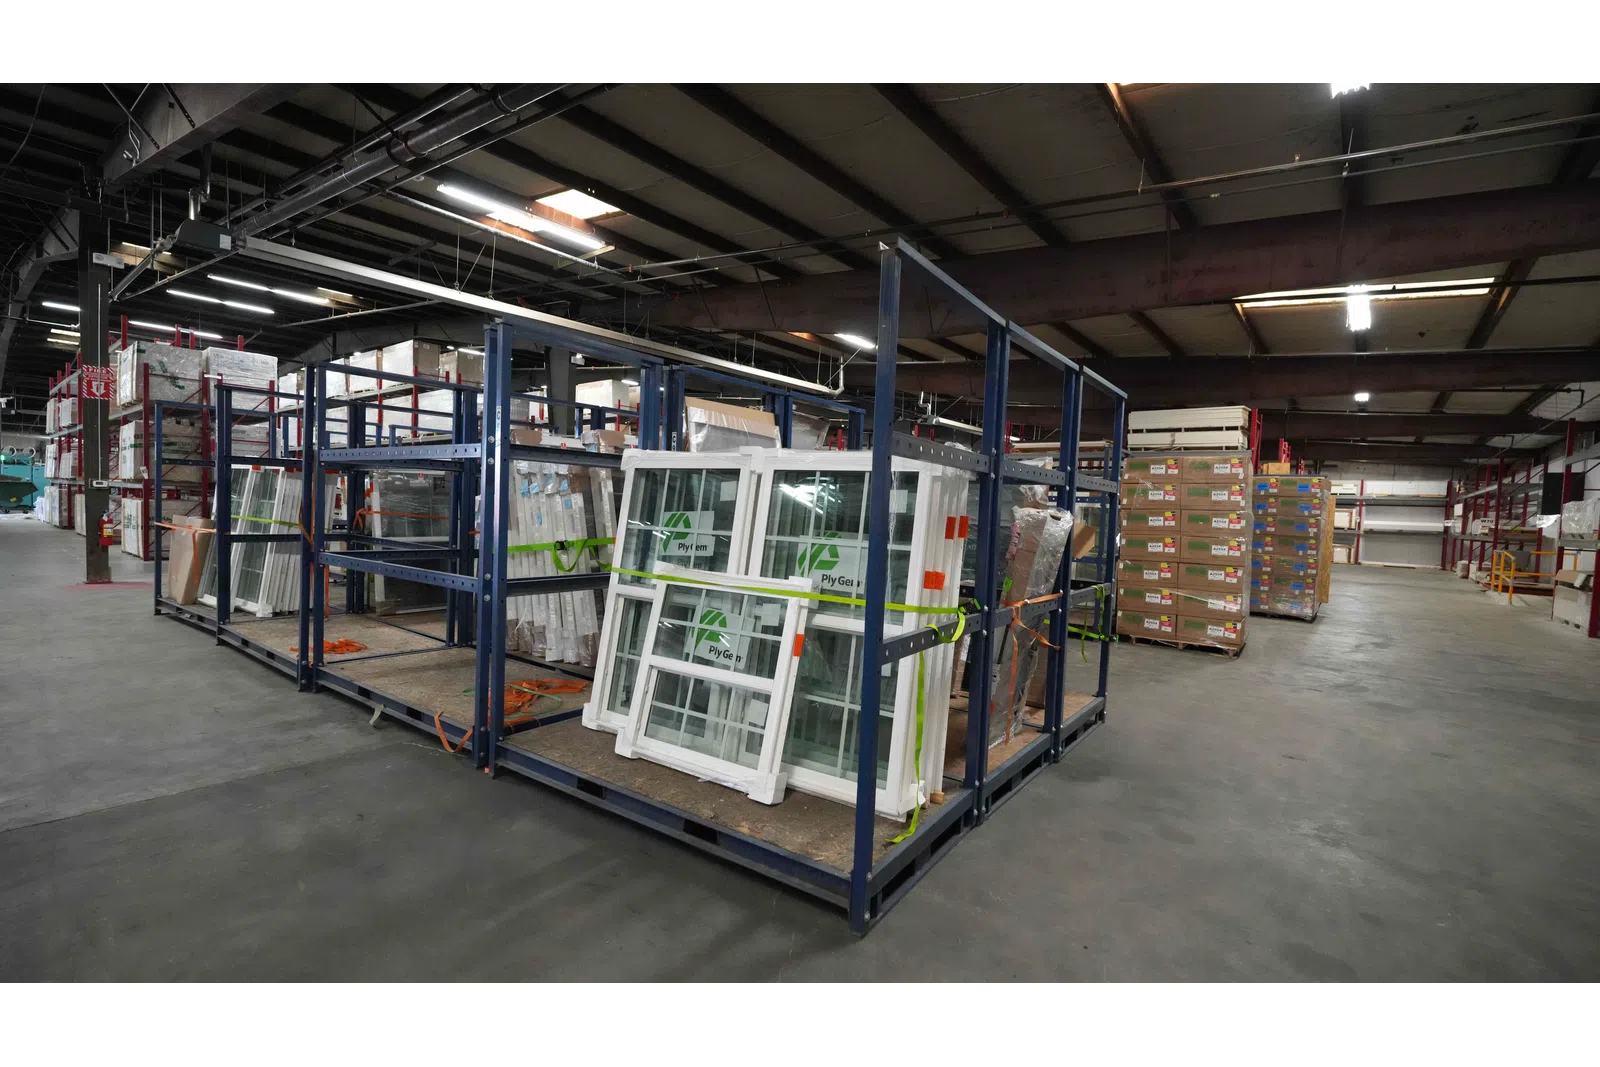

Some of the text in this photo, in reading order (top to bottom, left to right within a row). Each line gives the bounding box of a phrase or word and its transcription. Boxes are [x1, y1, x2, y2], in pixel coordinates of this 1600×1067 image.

[677, 542, 689, 553] Ply
[821, 573, 837, 587] Ply
[708, 645, 723, 659] Ply
